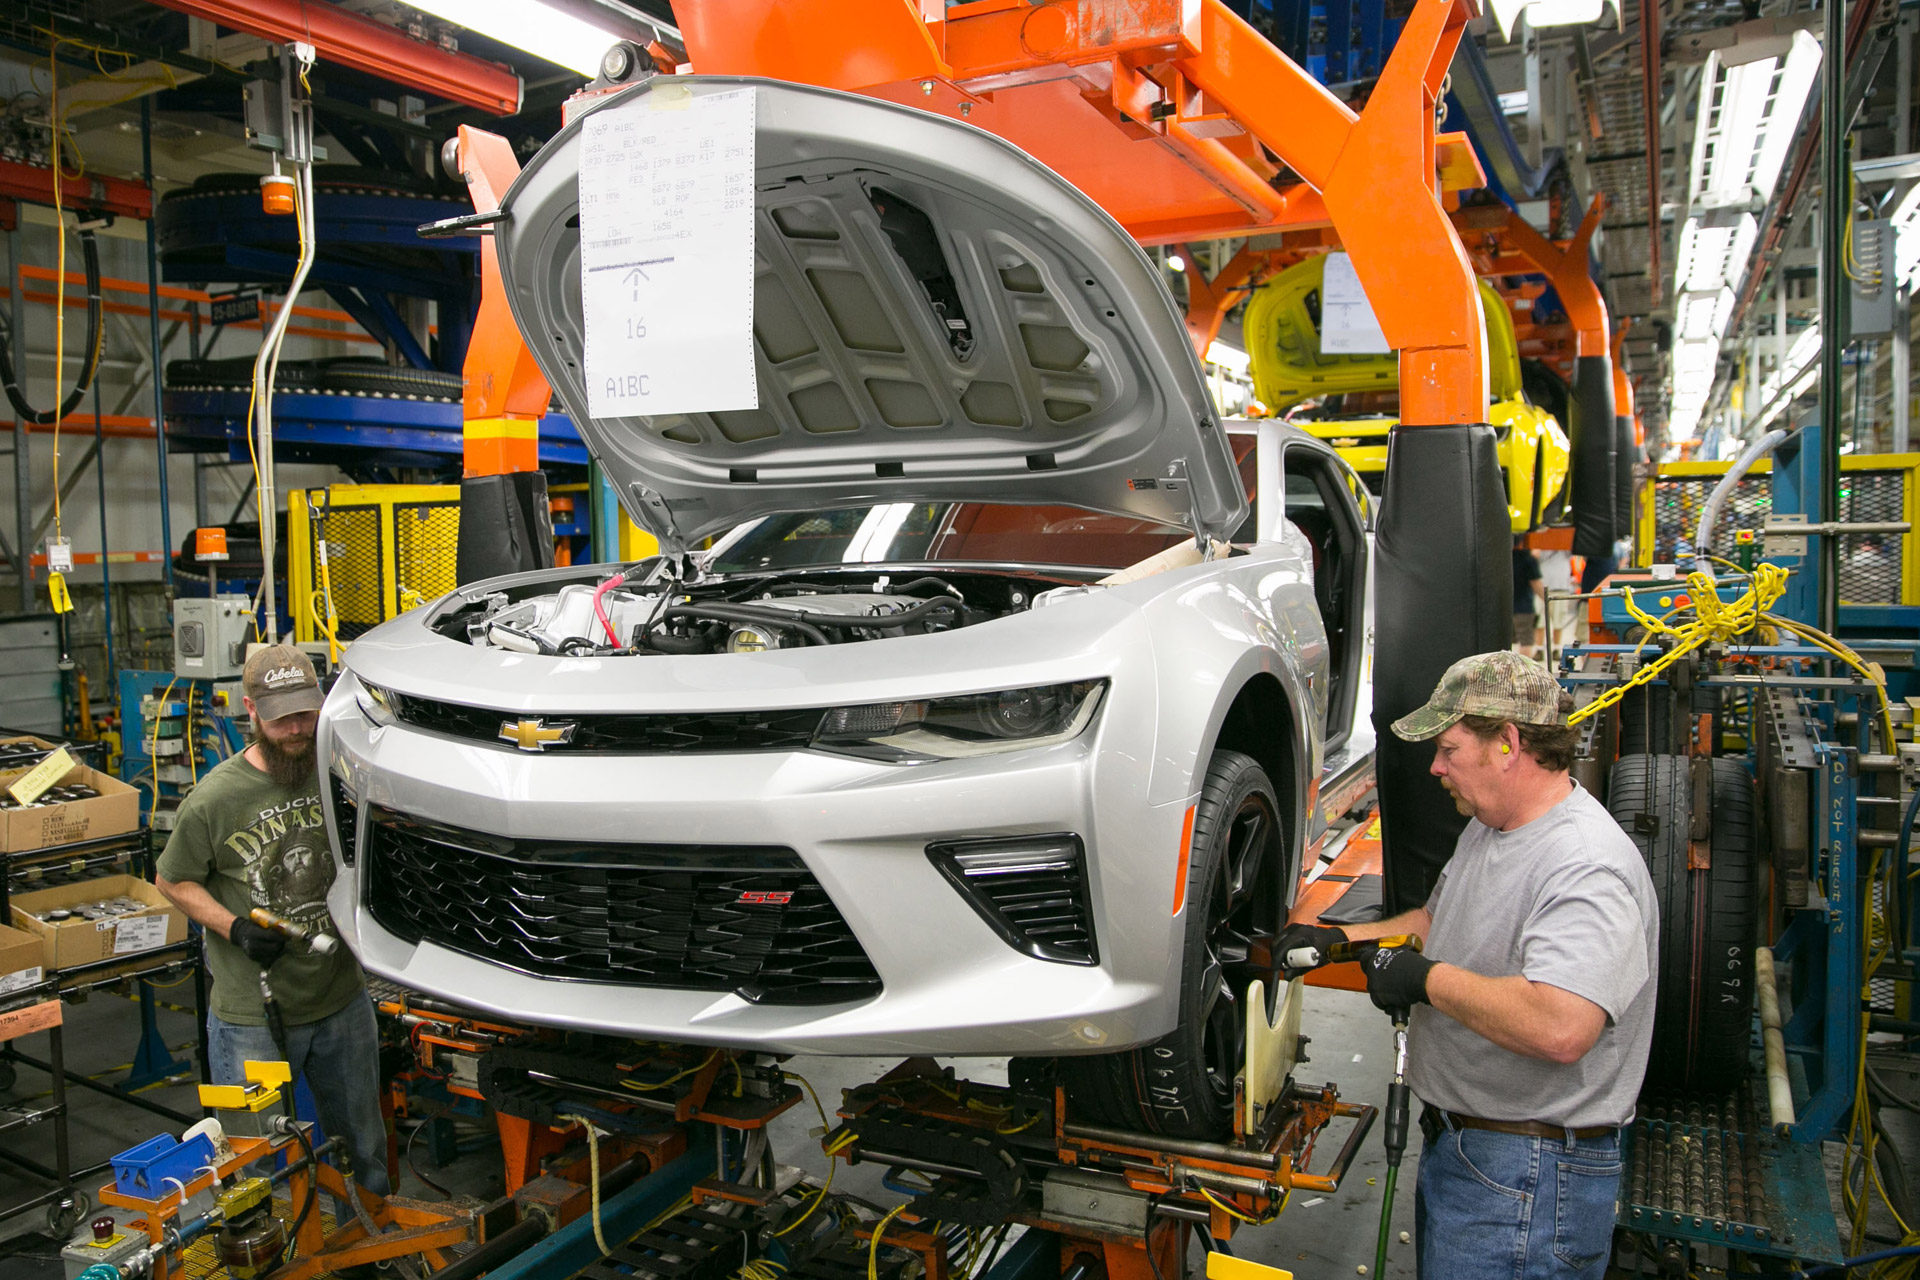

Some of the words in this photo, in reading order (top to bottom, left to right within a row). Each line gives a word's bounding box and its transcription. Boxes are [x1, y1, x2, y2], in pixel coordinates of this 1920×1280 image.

[615, 123, 635, 132] A1BC
[605, 153, 626, 163] 2725
[700, 152, 716, 161] K17
[724, 148, 744, 158] 2751
[652, 158, 671, 169] 1379
[725, 173, 744, 183] 1657
[585, 195, 598, 204] LT1
[724, 199, 744, 210] 2219
[627, 317, 647, 339] 16
[606, 375, 650, 399] A1BC
[1833, 761, 1845, 785] DO
[258, 794, 321, 821] DUCK
[1832, 796, 1845, 833] NOT
[223, 803, 324, 866] DYNAS
[1831, 840, 1843, 903] REACH
[735, 890, 795, 904] SS
[310, 907, 329, 920] BRO
[97, 922, 105, 931] 21
